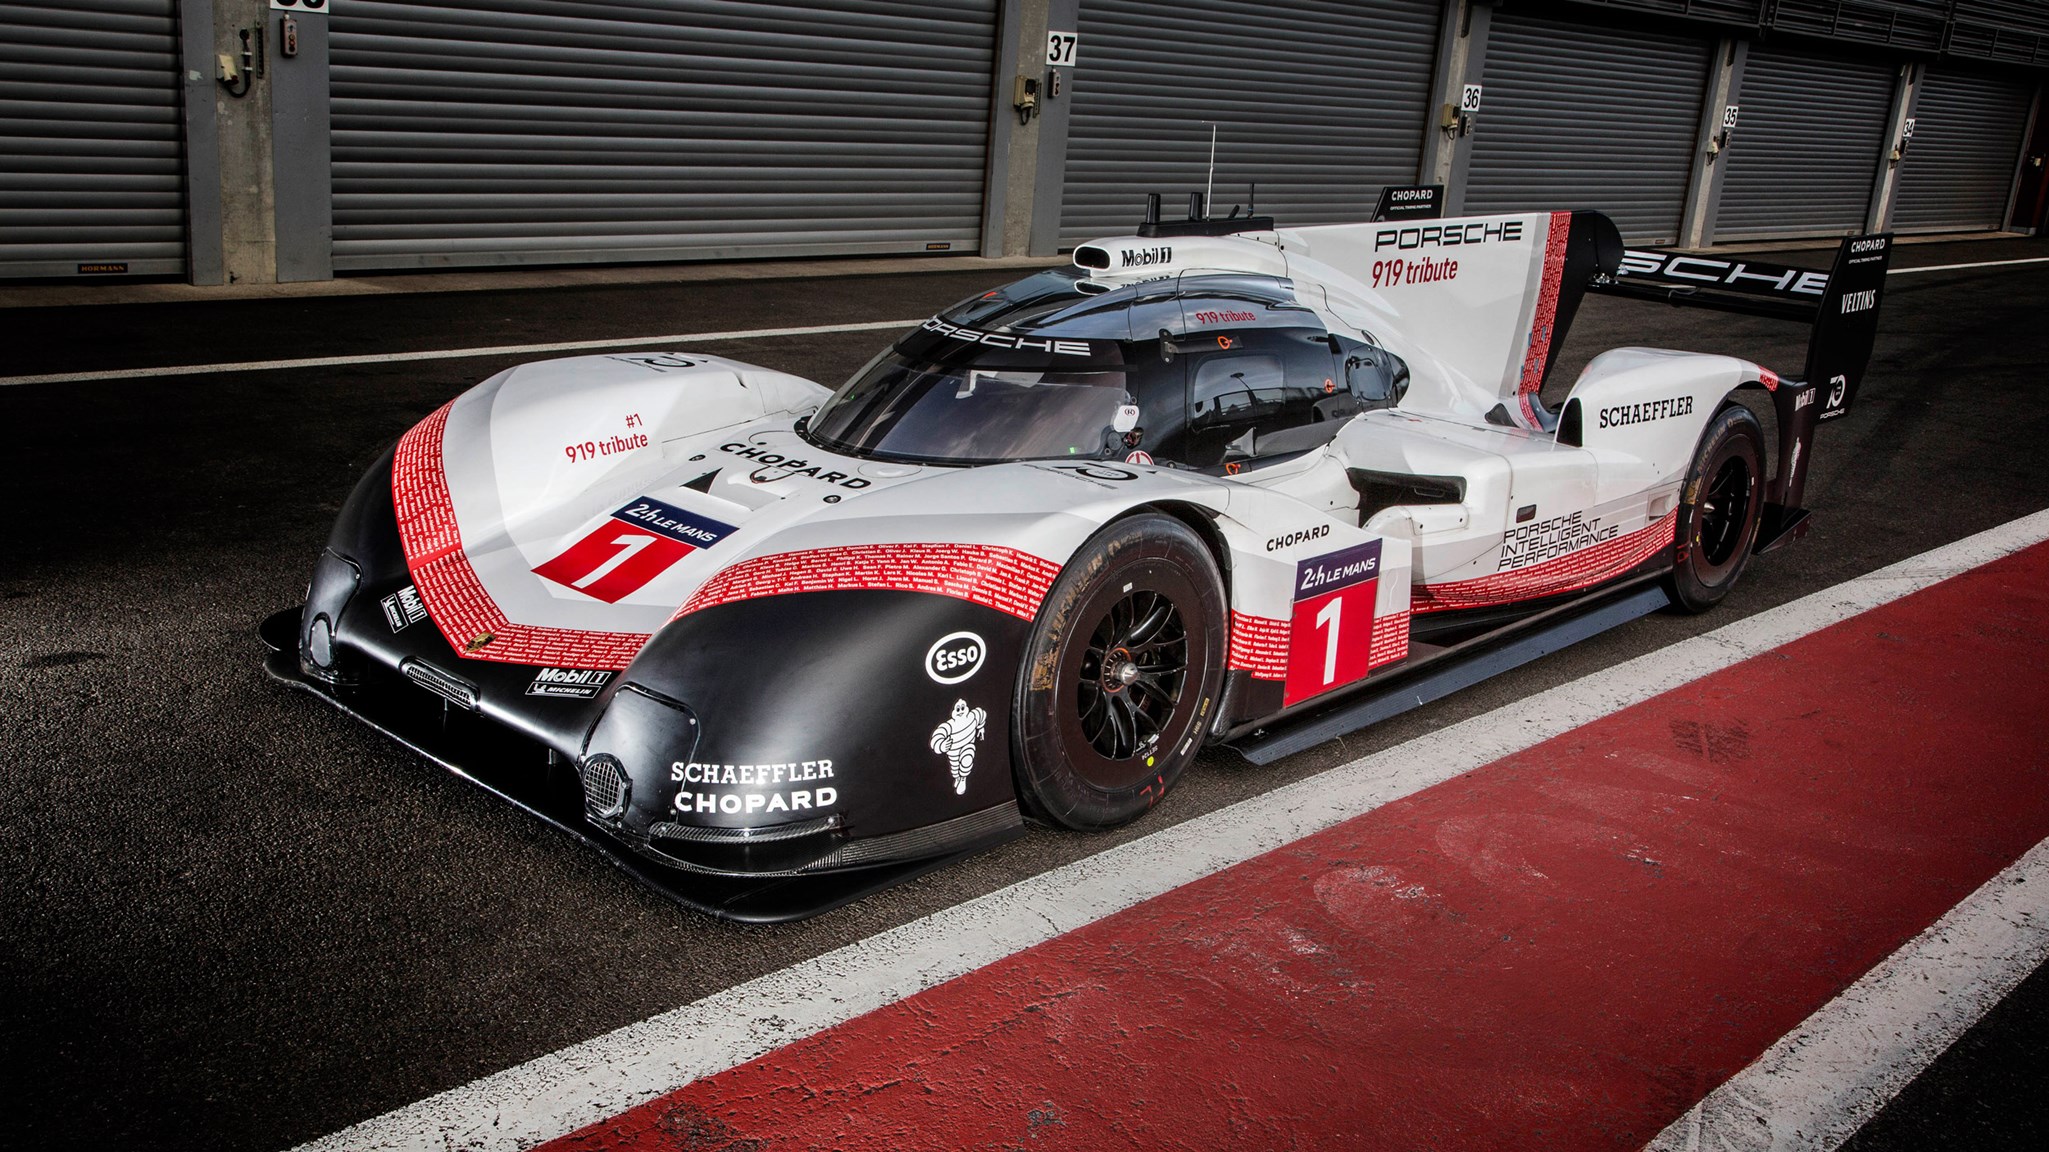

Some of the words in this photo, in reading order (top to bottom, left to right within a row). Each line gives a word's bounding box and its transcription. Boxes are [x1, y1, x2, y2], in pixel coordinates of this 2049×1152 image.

[1049, 35, 1075, 62] 37
[1464, 88, 1479, 108] 36
[1725, 108, 1737, 125] 35
[1391, 190, 1433, 201] CHOPARD
[1375, 221, 1523, 252] PORSCHE
[1851, 238, 1885, 253] CHOPARD
[1121, 247, 1159, 267] Mobil
[1159, 247, 1172, 263] 1
[1372, 259, 1403, 288] 919
[1406, 256, 1458, 284] tribute
[1621, 250, 1829, 295] SCHE
[1841, 289, 1876, 314] VELTINS
[1196, 311, 1218, 324] 919
[1219, 310, 1256, 322] tribute
[626, 413, 643, 428] #1
[1599, 395, 1693, 429] SCHAEFFLER
[565, 441, 596, 463] 919
[599, 433, 648, 455] tribute
[720, 443, 872, 489] CHOPARD
[625, 504, 658, 522] 24h
[653, 517, 672, 528] LE
[670, 524, 718, 542] MANS
[1503, 511, 1582, 544] PORSCHE
[1266, 524, 1330, 552] CHOPARD
[1497, 525, 1619, 571] PERFORMANCE
[1501, 517, 1601, 558] INTELLIGENT
[571, 535, 658, 589] 1
[950, 567, 976, 576] Christoph
[1301, 564, 1325, 590] 24h
[1326, 567, 1342, 583] LE
[1342, 557, 1376, 578] MANS
[397, 584, 423, 615] Mobil
[1316, 596, 1342, 686] 1
[535, 667, 591, 684] Mobil
[547, 686, 593, 694] MICHELIN
[671, 759, 834, 785] SCHAEFFLER
[674, 786, 837, 814] CHOPARD
